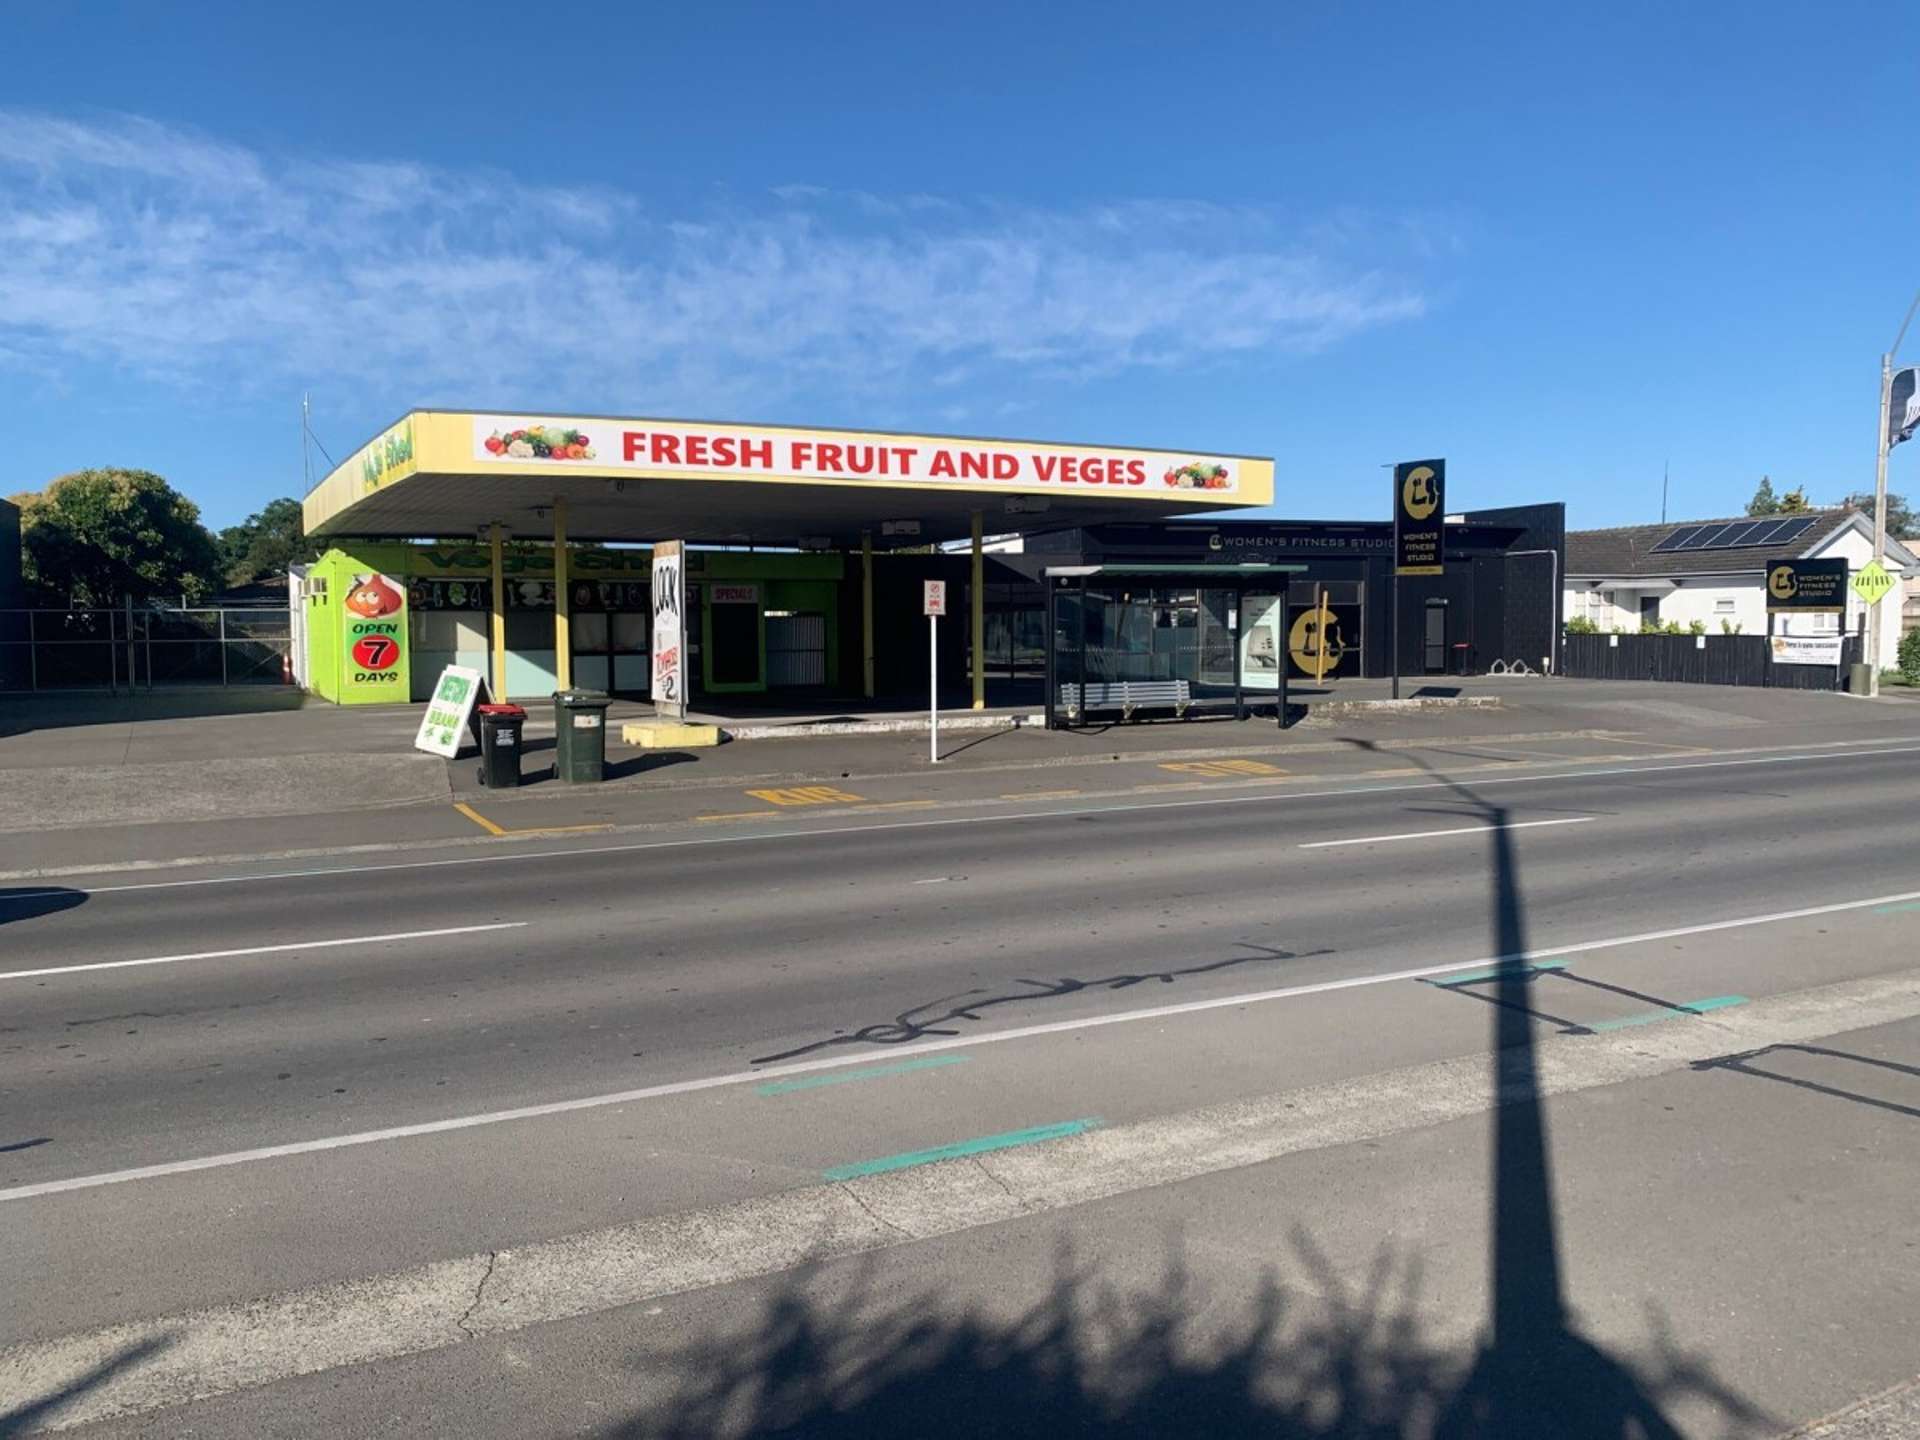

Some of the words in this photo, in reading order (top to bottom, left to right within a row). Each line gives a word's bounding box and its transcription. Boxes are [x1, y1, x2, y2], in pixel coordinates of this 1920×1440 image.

[623, 431, 773, 468] FRESH
[791, 442, 918, 475] FRUIT
[929, 450, 1019, 480] AND
[1032, 455, 1146, 485] VEGES
[1404, 532, 1438, 540] WOMEN'S
[1223, 537, 1287, 547] WOMEN'S
[1292, 537, 1345, 547] FITNESS
[1799, 574, 1841, 582] WOMEN'S
[352, 623, 399, 634] OPEN
[361, 640, 391, 667] 7
[354, 671, 399, 683] DAYS
